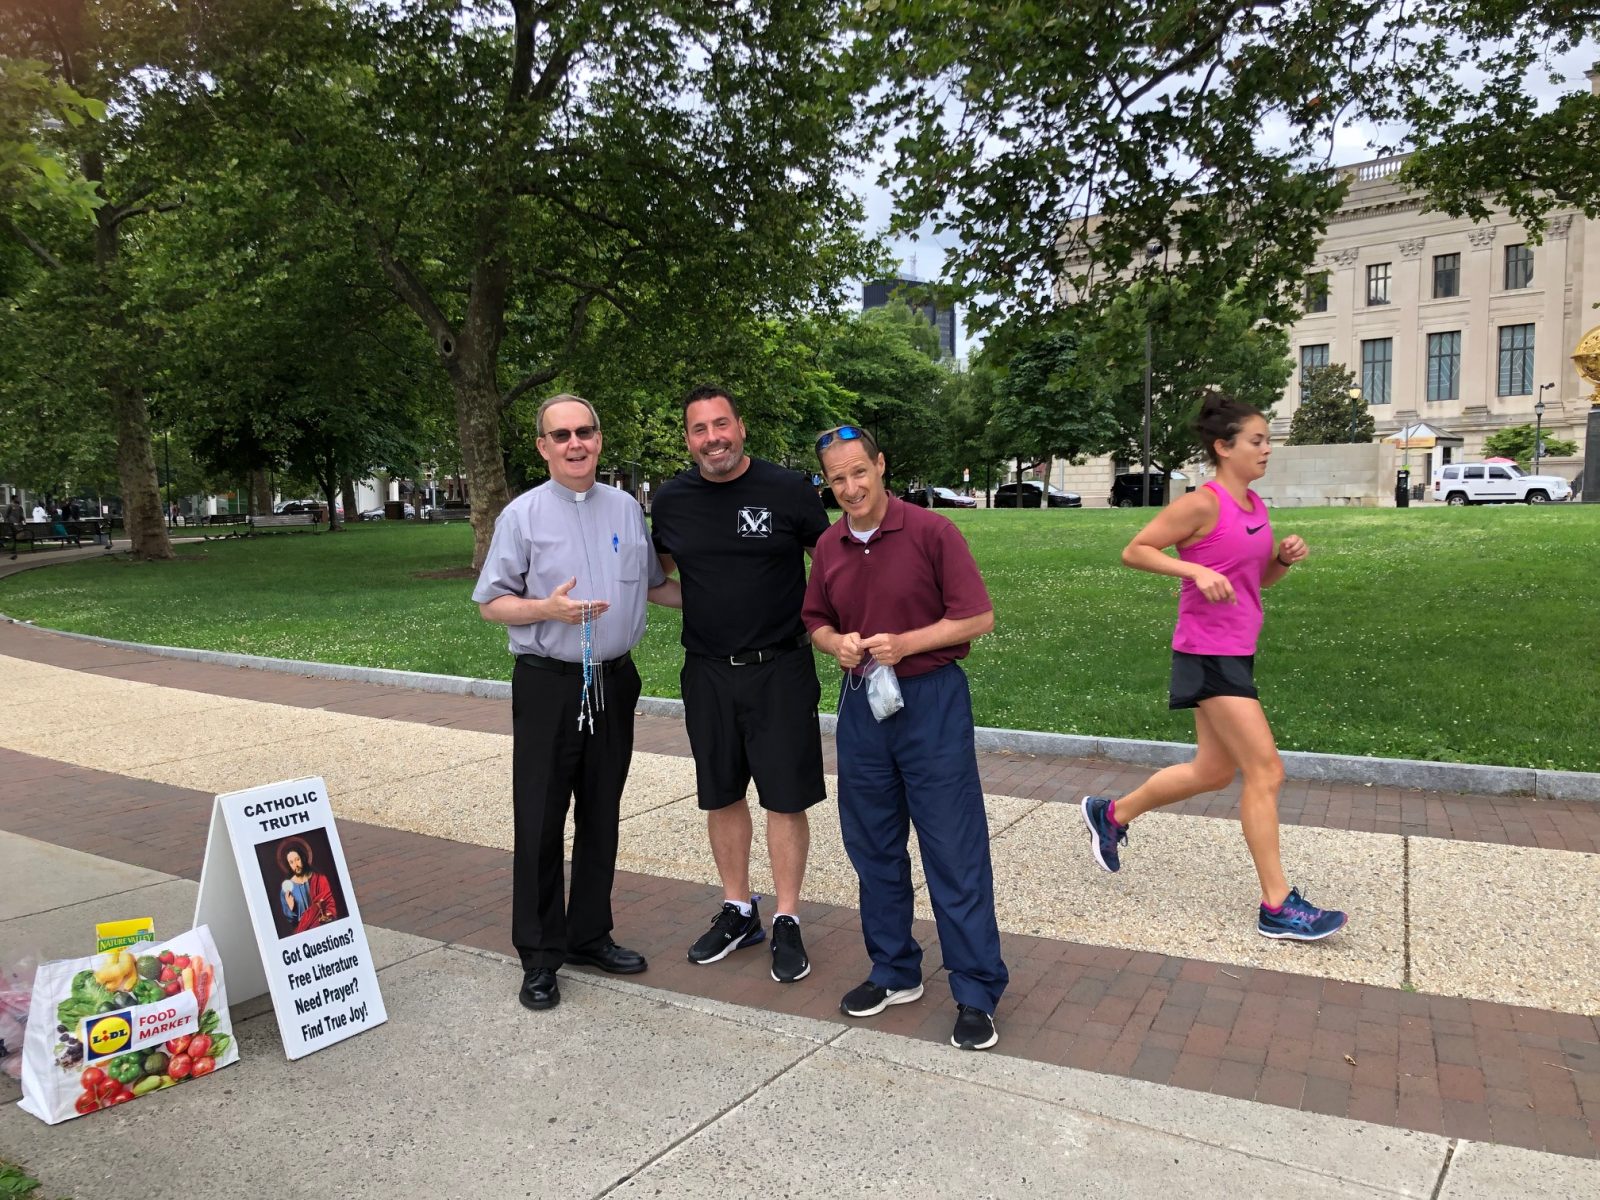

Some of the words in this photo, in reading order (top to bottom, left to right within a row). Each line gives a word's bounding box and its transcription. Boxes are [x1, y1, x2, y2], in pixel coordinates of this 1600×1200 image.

[243, 791, 318, 817] CATHOLIC
[259, 810, 310, 832] TRUTH
[100, 937, 127, 951] NATURE
[282, 947, 303, 966] Got
[302, 928, 355, 959] Questions?
[288, 972, 312, 990] Free
[312, 955, 359, 981] Literature
[294, 991, 323, 1016] Need
[322, 977, 359, 1005] Prayer?
[139, 1008, 177, 1027] FOOD
[139, 1015, 191, 1040] MARKET
[301, 1019, 324, 1042] Find
[324, 1013, 347, 1032] True
[349, 1001, 369, 1023] Joy!
